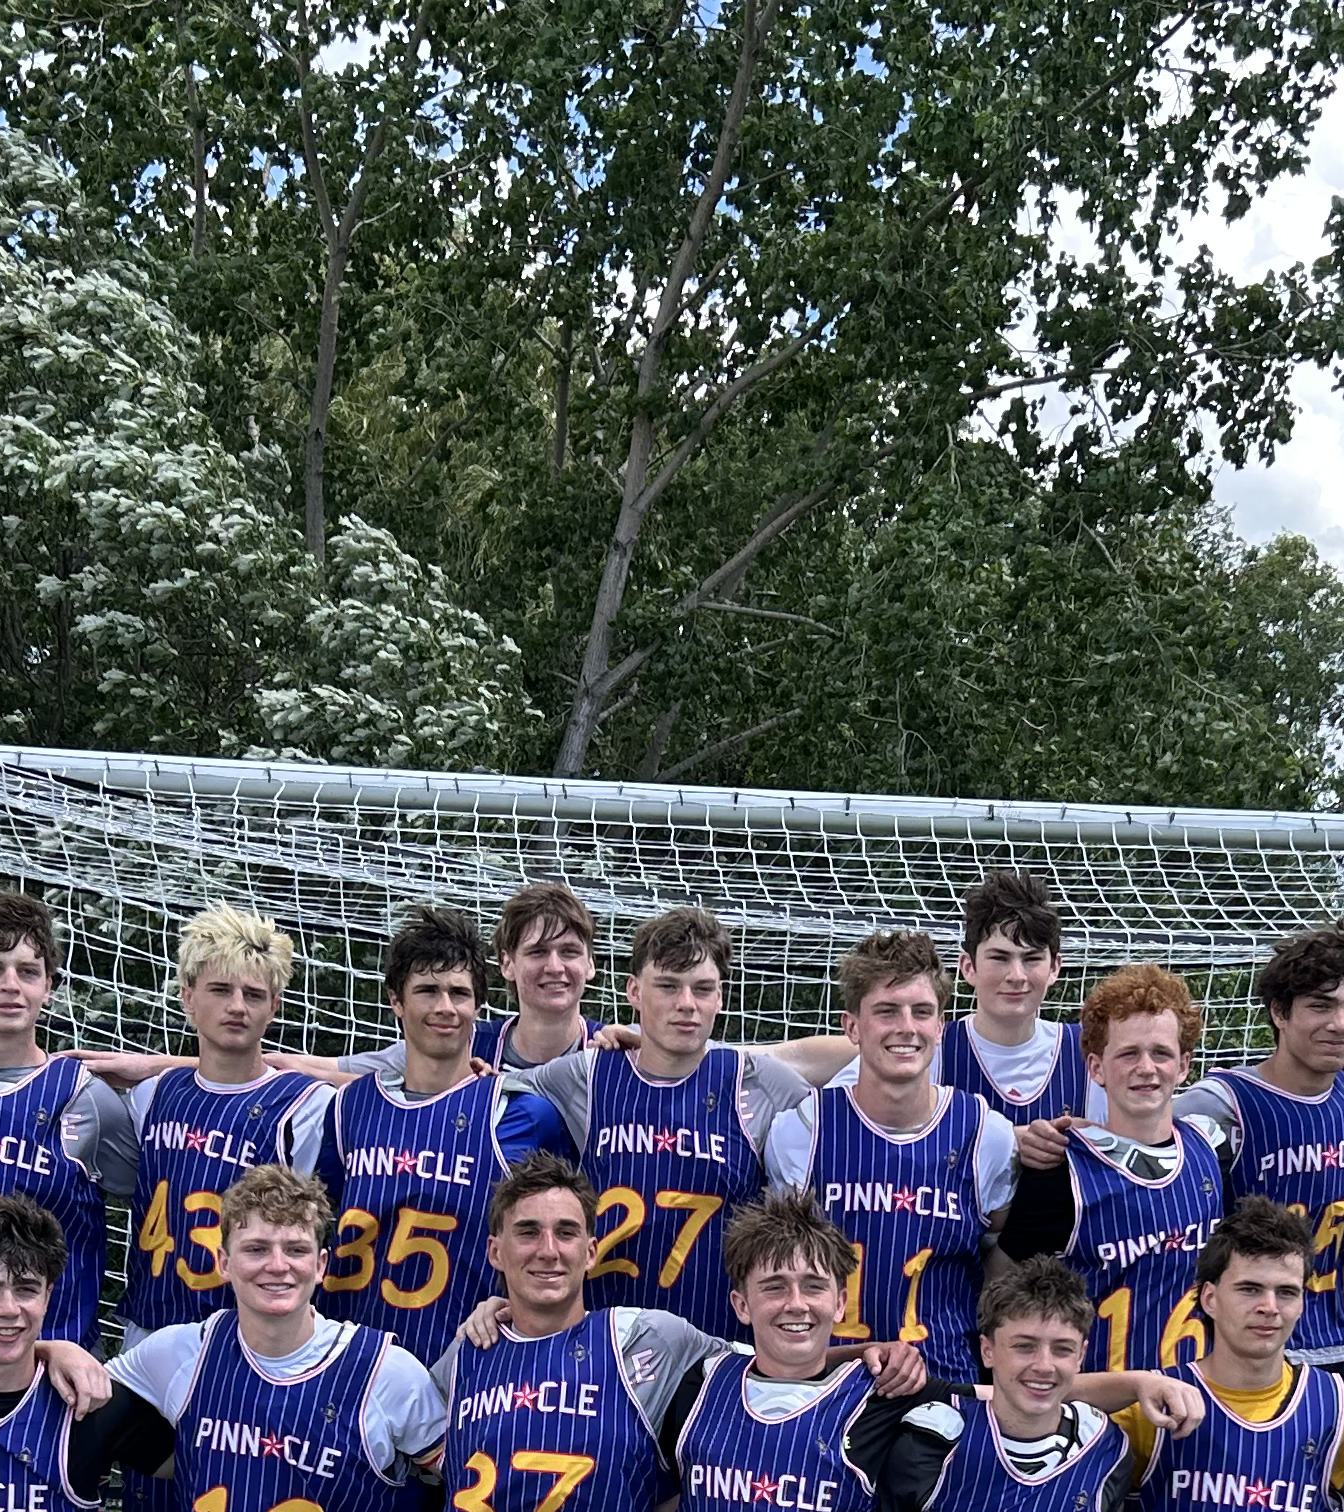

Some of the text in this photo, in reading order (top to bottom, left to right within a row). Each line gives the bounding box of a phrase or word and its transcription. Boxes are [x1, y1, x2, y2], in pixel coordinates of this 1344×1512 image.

[139, 1180, 231, 1291] 43
[322, 1207, 458, 1309] 35
[587, 1186, 723, 1289] 27
[831, 1242, 934, 1343] 11
[1097, 1287, 1205, 1372] 16
